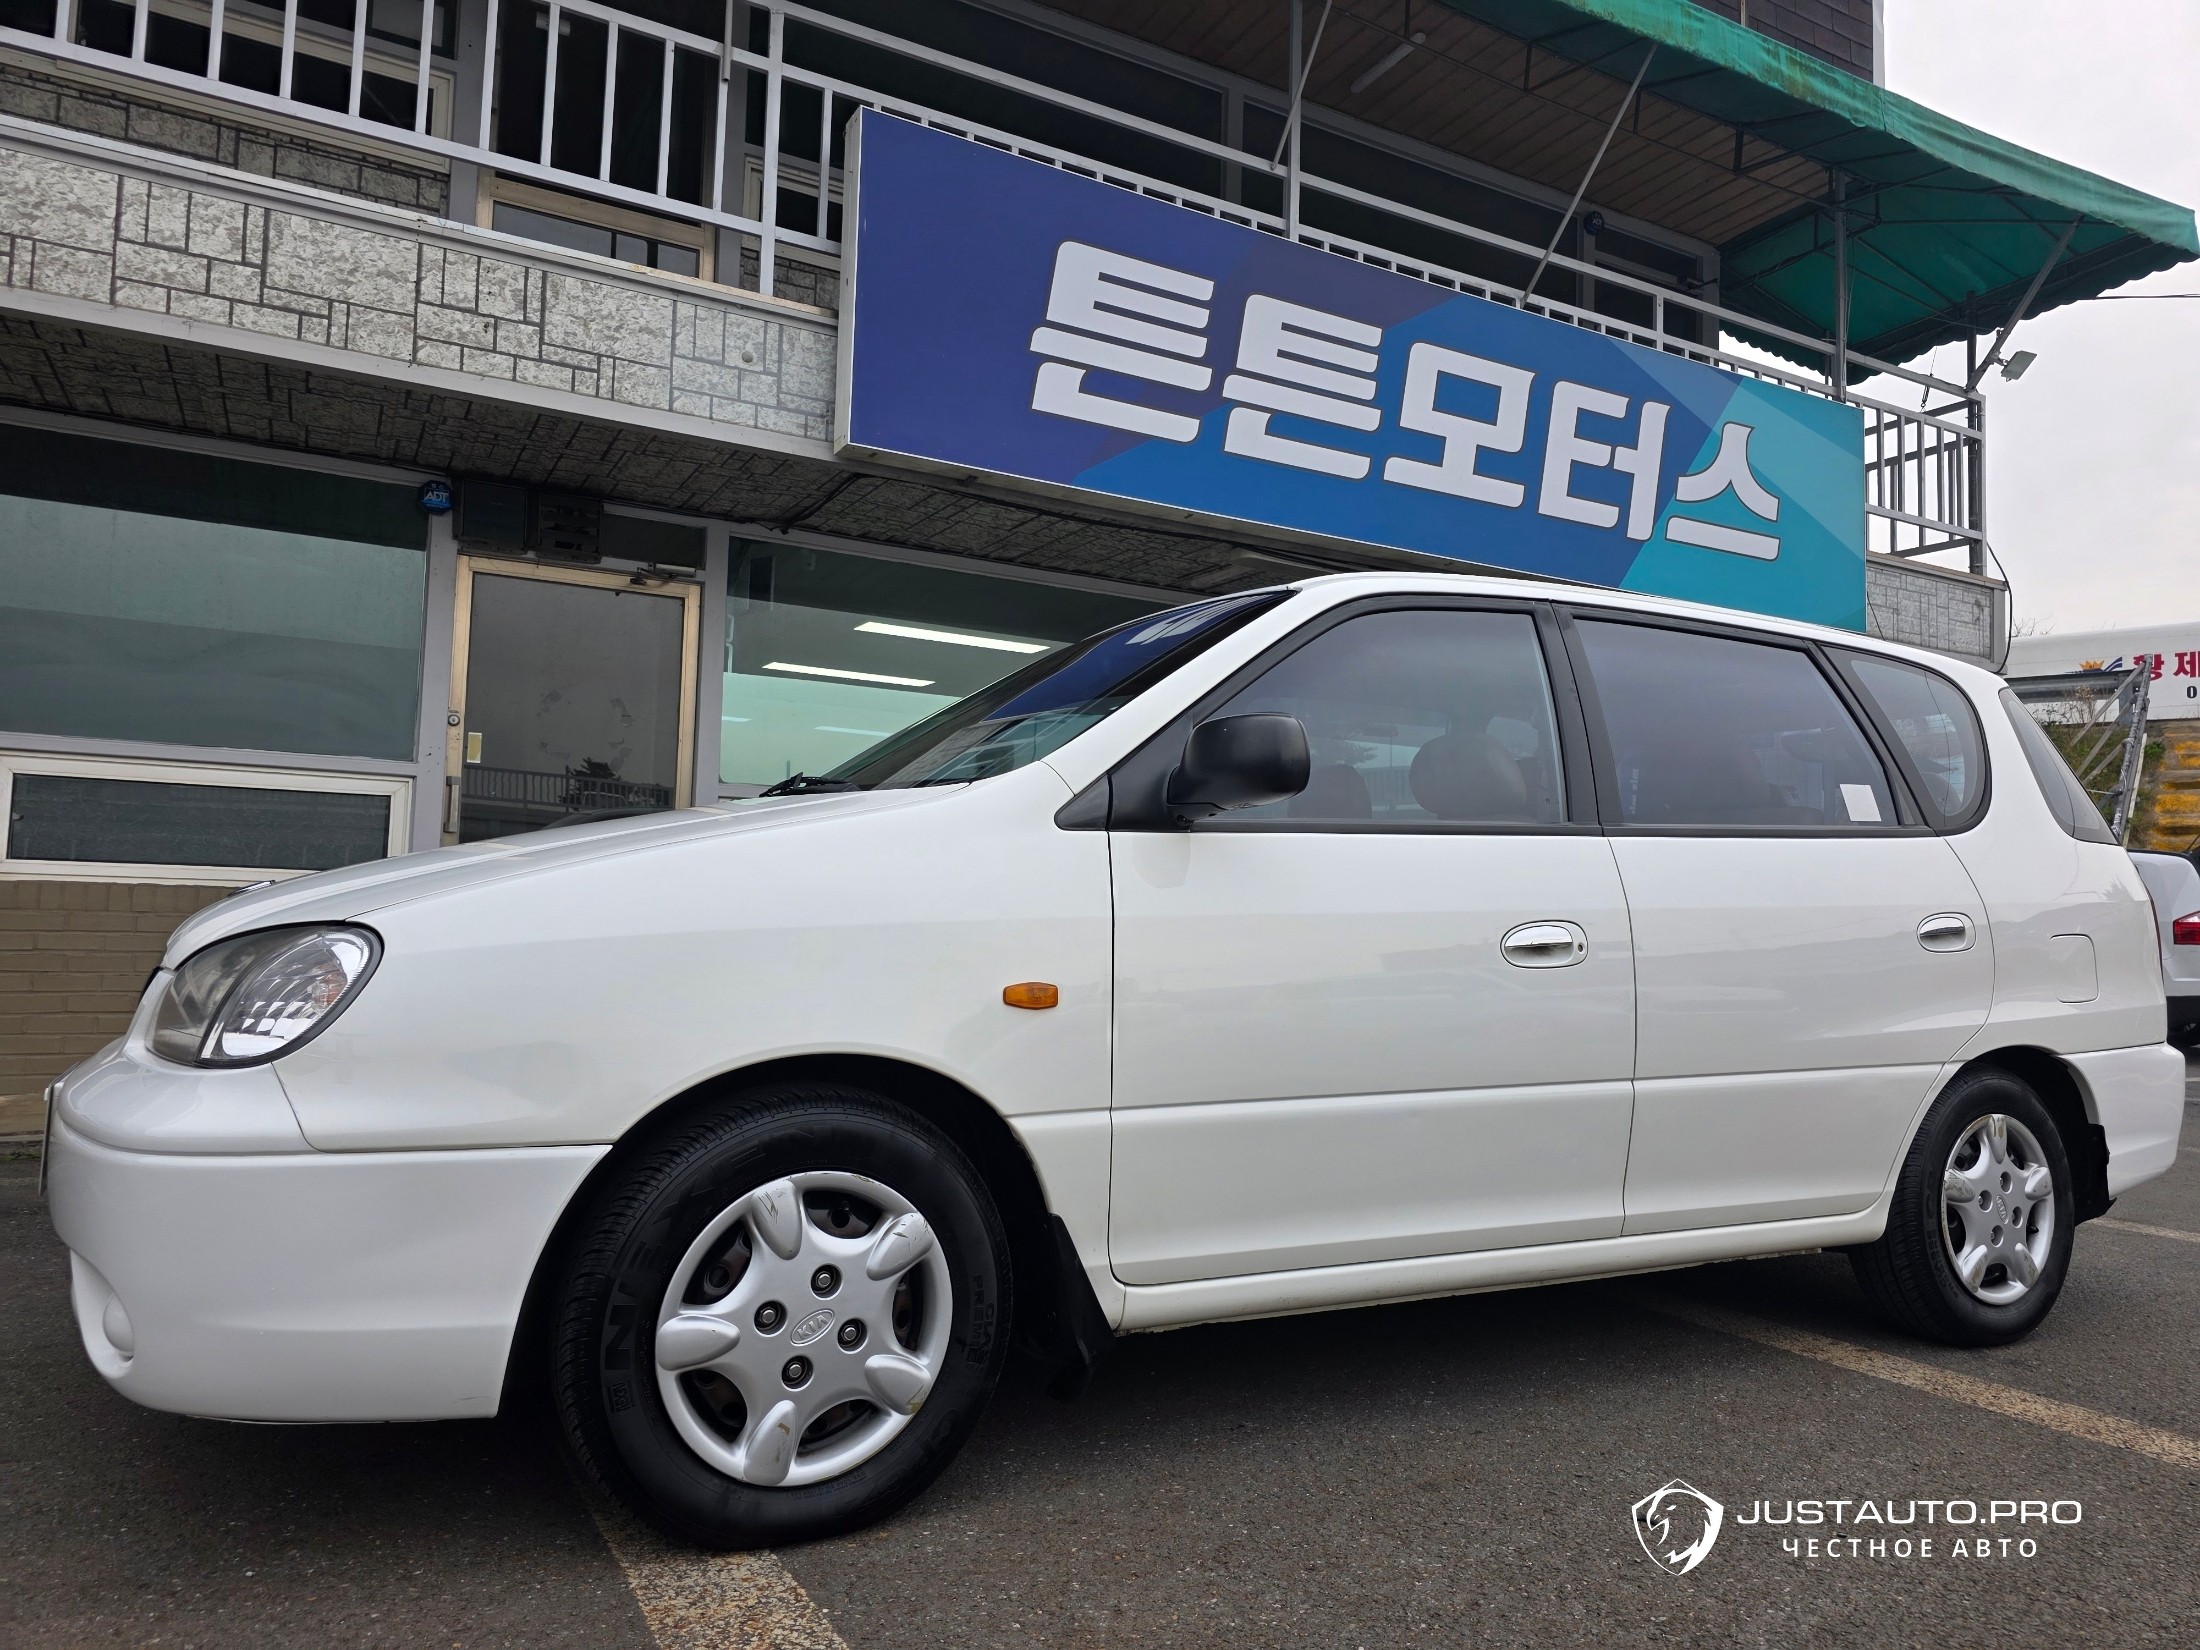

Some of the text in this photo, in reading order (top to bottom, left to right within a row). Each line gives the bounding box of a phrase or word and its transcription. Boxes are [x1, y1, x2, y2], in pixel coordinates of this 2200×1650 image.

[1028, 240, 1781, 561] 튼튼모터스
[424, 490, 449, 503] ADT
[796, 1314, 829, 1340] KIA
